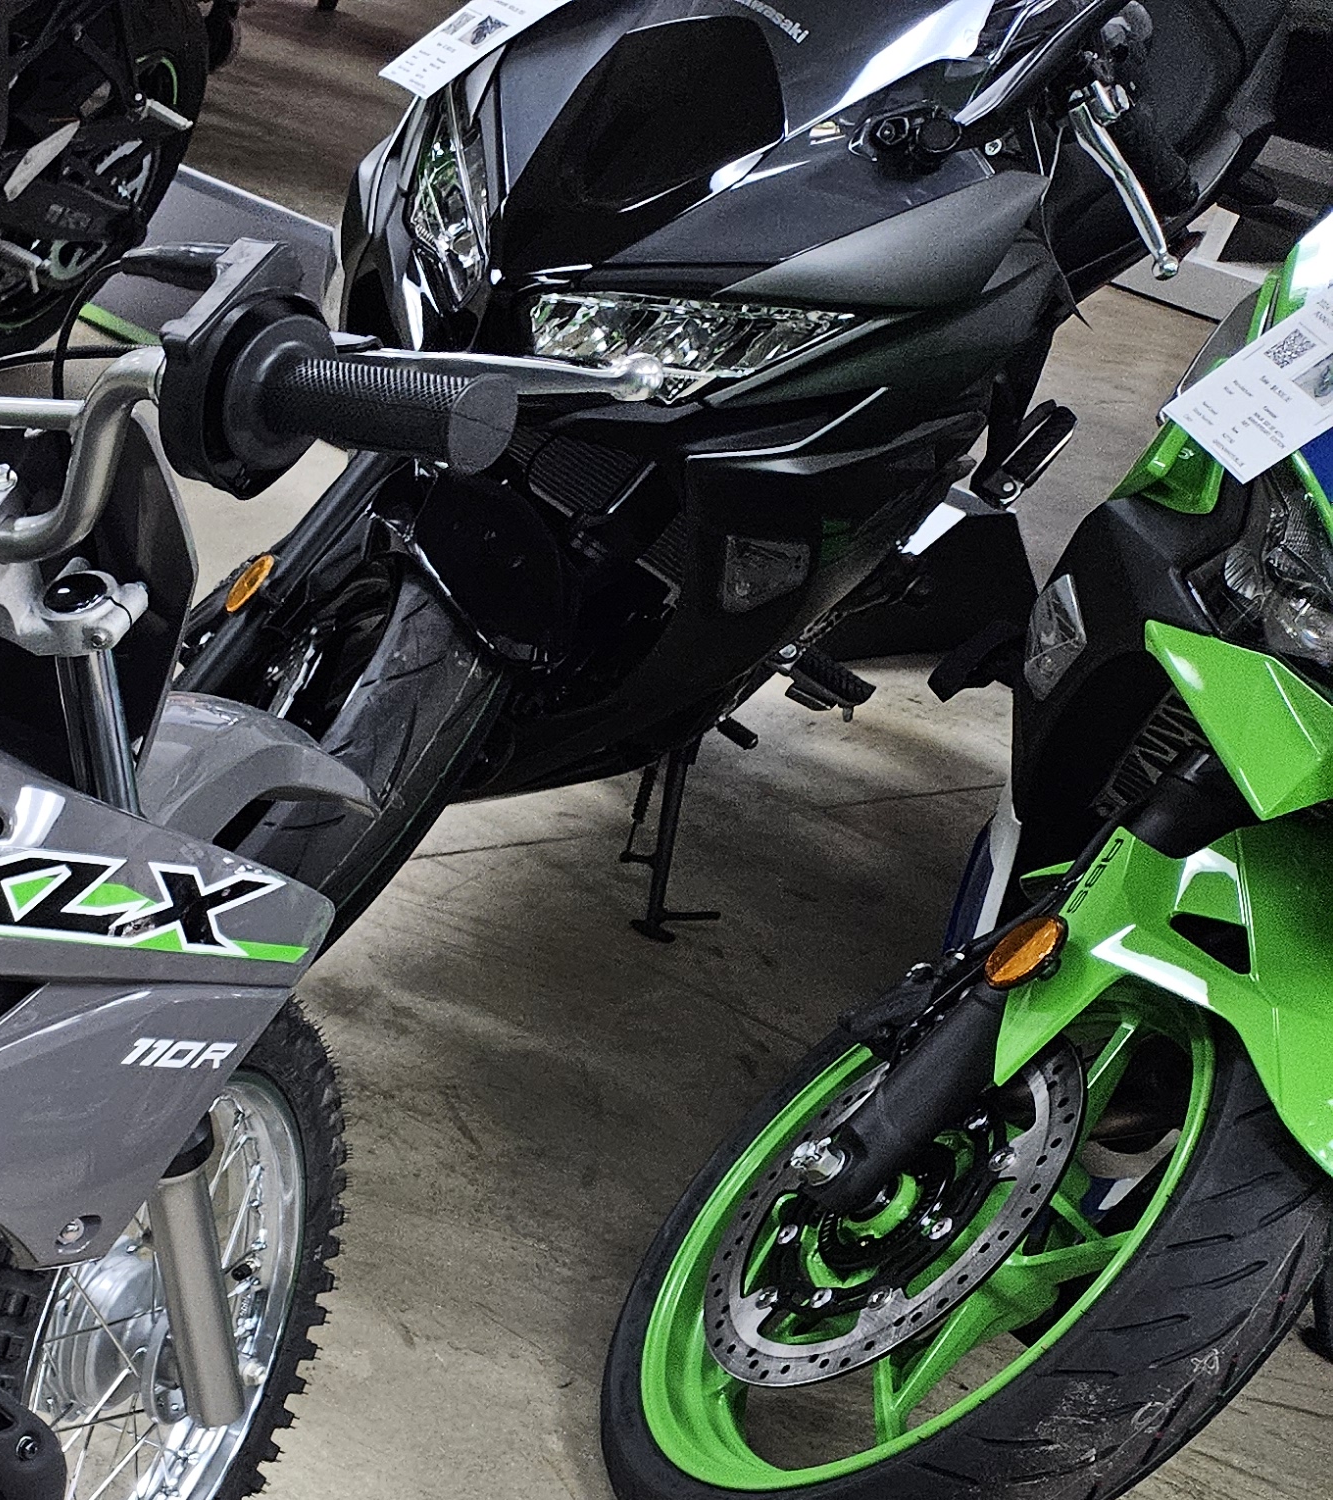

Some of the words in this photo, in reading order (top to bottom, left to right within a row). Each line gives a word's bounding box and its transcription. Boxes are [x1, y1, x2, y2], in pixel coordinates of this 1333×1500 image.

[735, 0, 810, 44] wasaki
[1066, 838, 1125, 914] ABS
[120, 1037, 238, 1069] 110R
